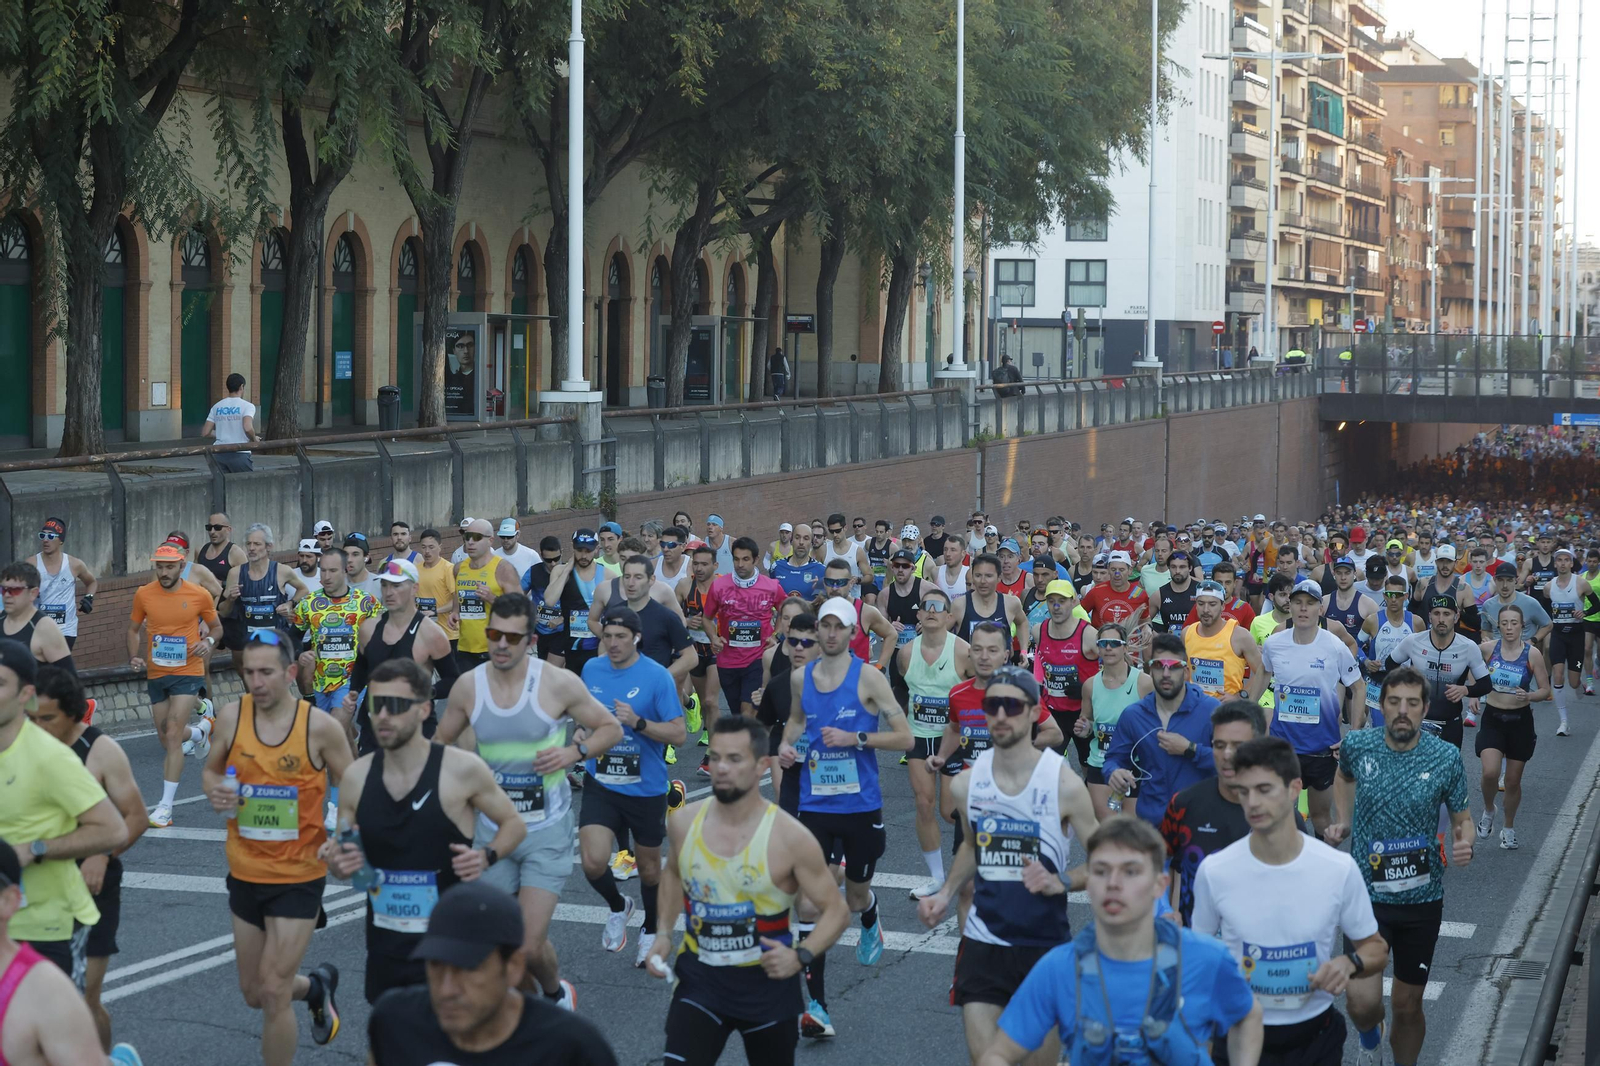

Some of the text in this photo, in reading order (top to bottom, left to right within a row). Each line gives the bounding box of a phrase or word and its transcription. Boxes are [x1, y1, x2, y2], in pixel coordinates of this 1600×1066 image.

[216, 407, 241, 415] HOKA
[1195, 675, 1218, 684] VICTOR
[1496, 678, 1510, 686] LORI
[1288, 705, 1309, 714] CYRIL
[918, 714, 945, 723] MATTEO
[606, 765, 628, 775] ALEX
[505, 776, 536, 784] ZURICH
[820, 774, 845, 783] STIJN
[257, 787, 290, 797] ZURICH
[254, 815, 279, 826] IVAN
[1000, 822, 1034, 833] ZURICH
[1388, 840, 1420, 850] ZURICH
[1384, 865, 1417, 880] ISAAC
[388, 873, 427, 884] ZURICH
[387, 904, 420, 916] HUGO
[709, 906, 747, 917] ZURICH
[698, 935, 754, 951] ROBERTO
[1266, 948, 1308, 960] ZURICH
[1267, 969, 1290, 978] 6489
